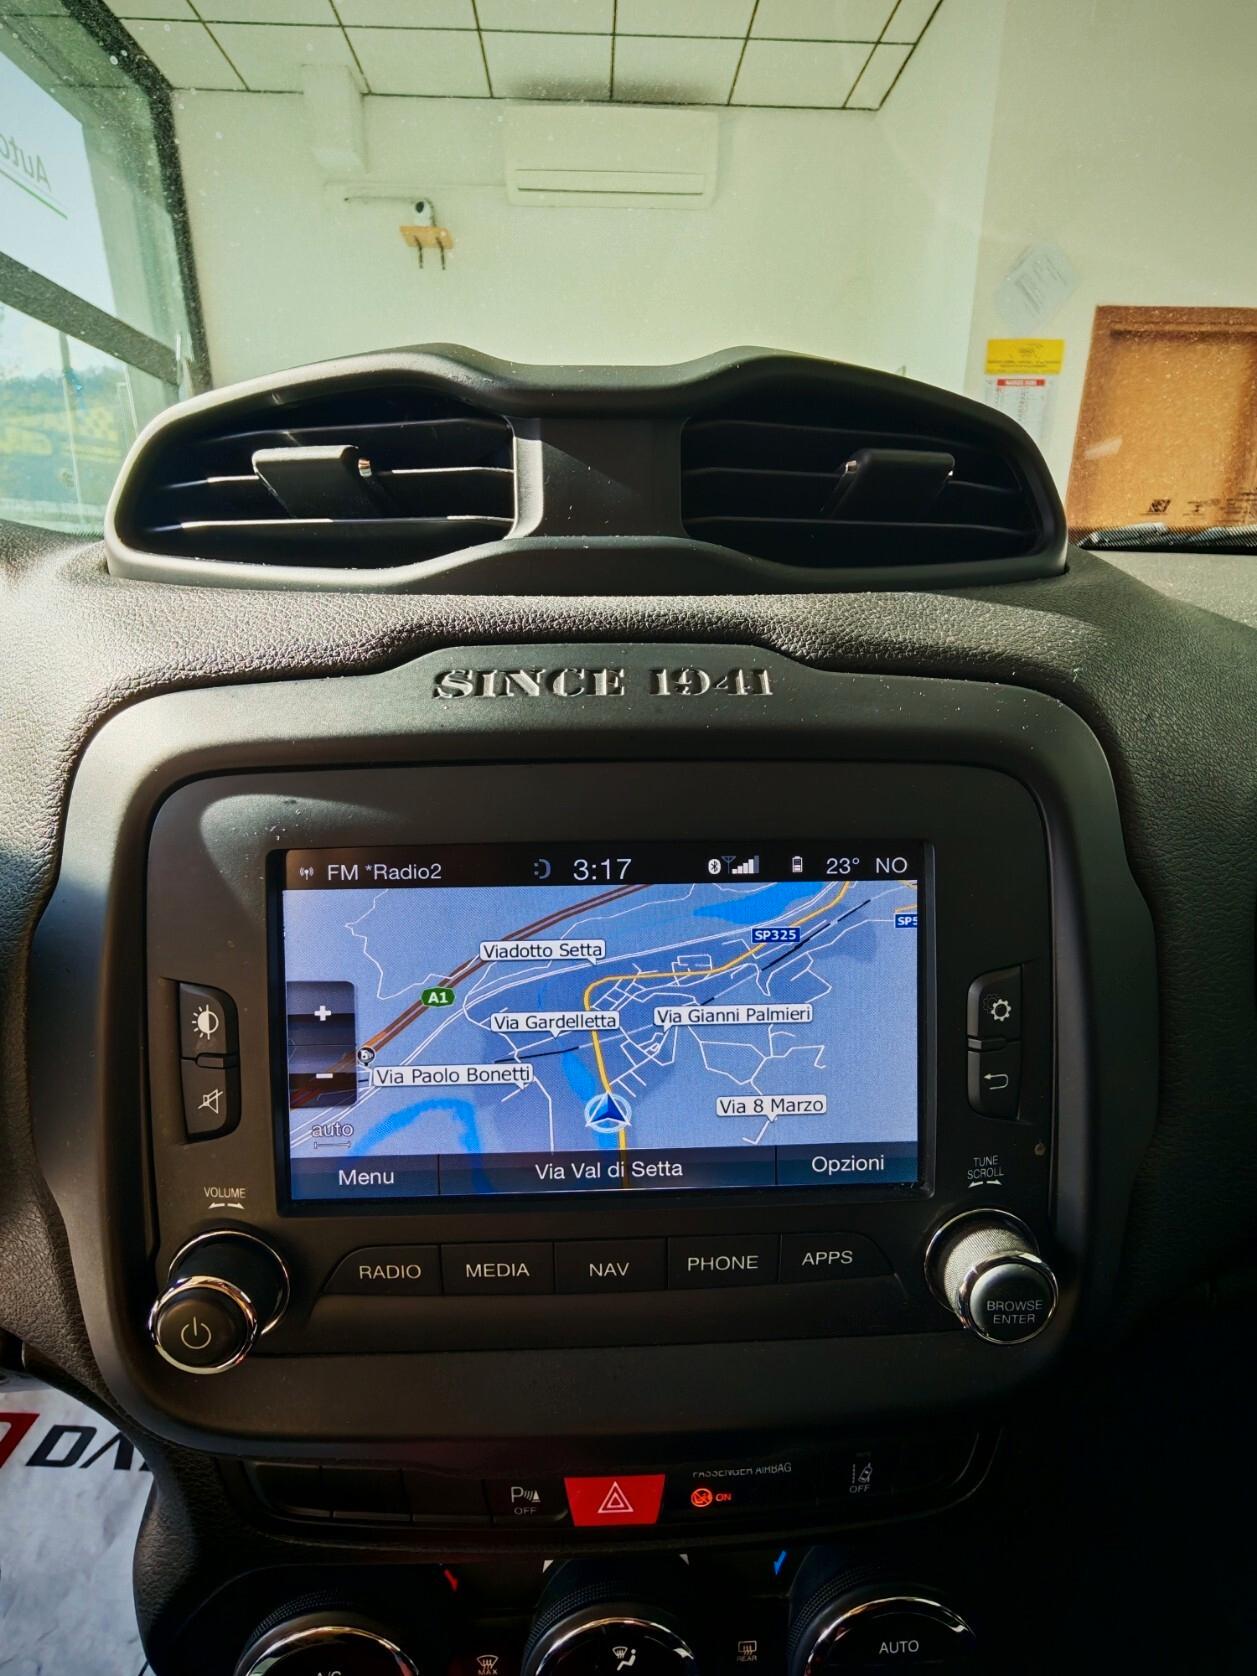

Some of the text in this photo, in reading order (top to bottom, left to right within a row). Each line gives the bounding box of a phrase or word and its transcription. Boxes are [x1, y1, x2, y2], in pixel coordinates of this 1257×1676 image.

[434, 668, 774, 699] SINCE 1941
[327, 864, 359, 881] FM
[573, 858, 632, 881] 3:17
[826, 857, 908, 875] 23° NO
[754, 930, 797, 941] SP325
[483, 942, 602, 959] Viadotto Setta
[428, 992, 449, 1004] A1
[494, 1013, 617, 1030] Via Gardelletta
[657, 1006, 811, 1024] Via Gianni Palmieri
[376, 1065, 531, 1085] Via Paolo Bonetti
[719, 1097, 825, 1114] Via 8 Marzo
[311, 1121, 354, 1138] auto
[811, 1154, 885, 1175] Opzioni
[973, 1154, 999, 1167] TUNE
[338, 1169, 395, 1186] Menu
[534, 1160, 684, 1180] Via Val di Setta
[967, 1167, 1005, 1180] SCROLL
[203, 1187, 246, 1199] VOLUME
[687, 1255, 759, 1272] PHONE
[801, 1250, 853, 1266] APPS
[359, 1264, 422, 1280] RADIO
[465, 1262, 530, 1278] MEDIA
[589, 1262, 630, 1277] NAV
[986, 1300, 1043, 1312] BROWSE
[993, 1313, 1036, 1325] ENTER
[849, 1484, 871, 1494] OFF
[715, 1493, 732, 1502] ON
[513, 1506, 537, 1515] OFF
[879, 1640, 920, 1655] AUTO
